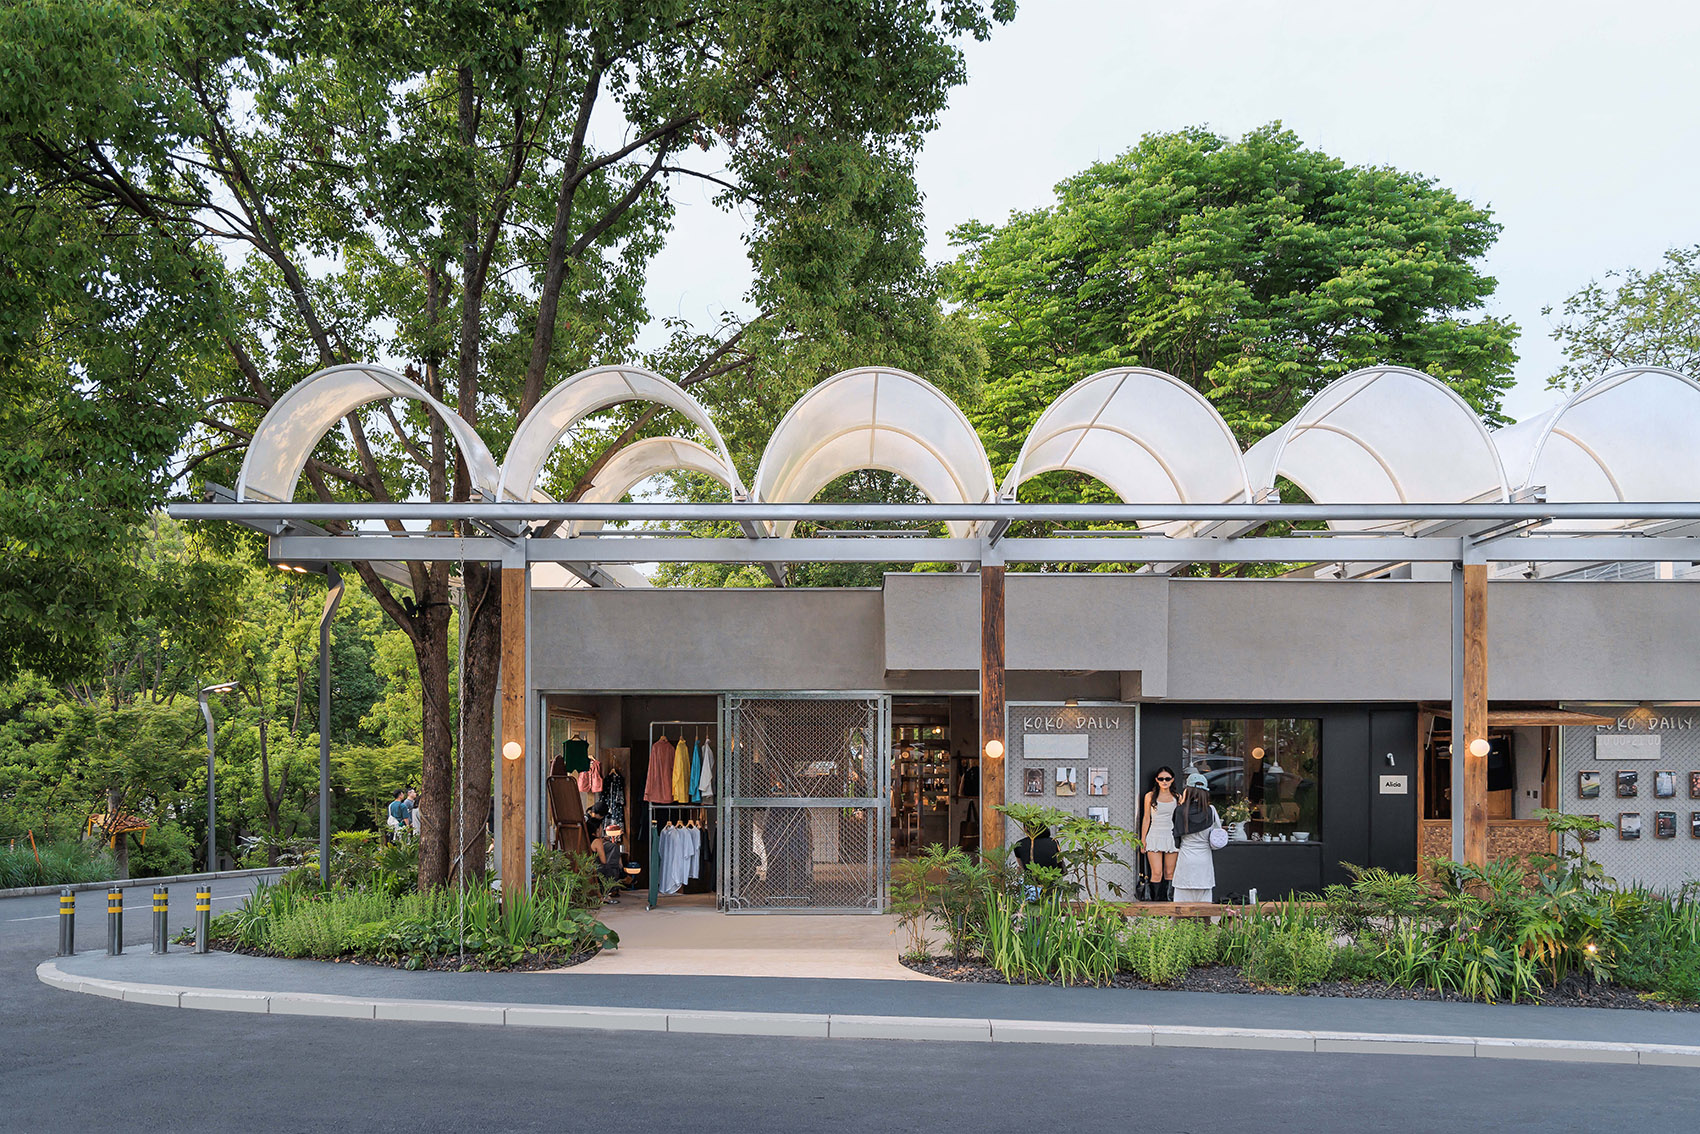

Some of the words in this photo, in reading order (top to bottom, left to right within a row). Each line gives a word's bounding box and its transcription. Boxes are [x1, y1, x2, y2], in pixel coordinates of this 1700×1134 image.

[1023, 716, 1063, 731] KOKO
[1075, 716, 1119, 729] DAILY
[1597, 717, 1635, 731] KO
[1648, 717, 1692, 730] DAILY
